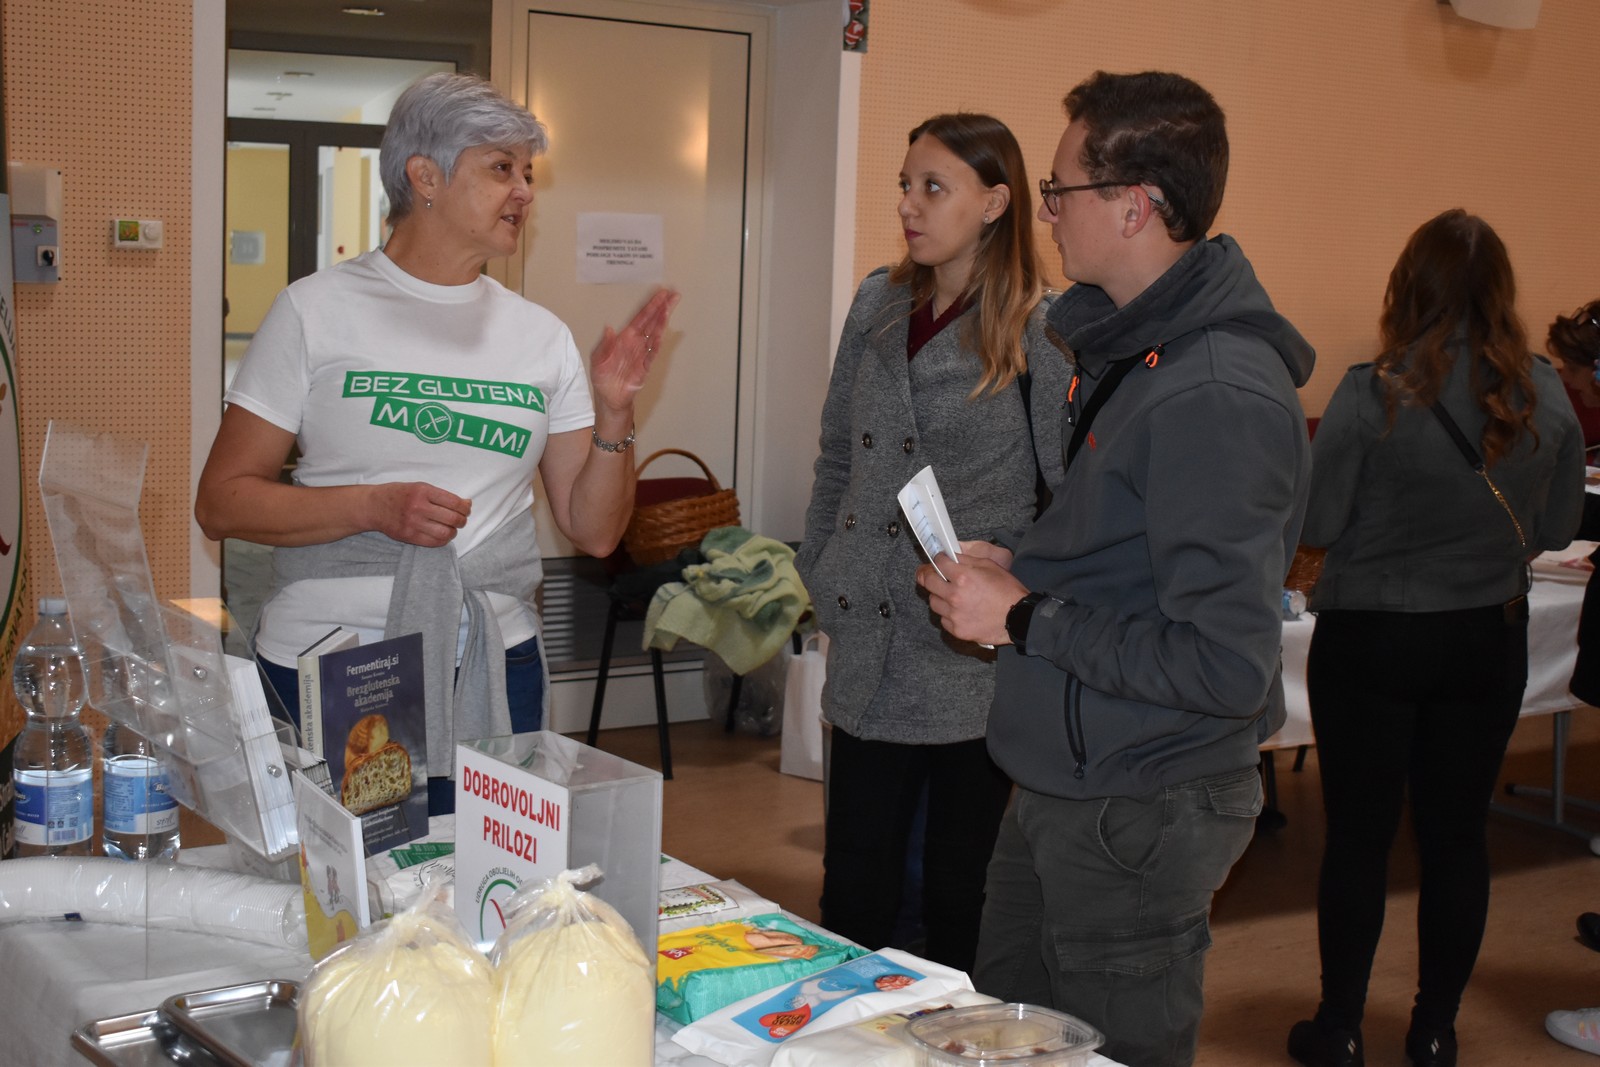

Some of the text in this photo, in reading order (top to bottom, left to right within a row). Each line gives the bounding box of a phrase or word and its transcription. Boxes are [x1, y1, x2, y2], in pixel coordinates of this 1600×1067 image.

[350, 376, 410, 394] BEZ
[346, 653, 399, 677] Fermentiraj.si
[303, 674, 314, 720] akademija
[346, 674, 401, 697] Brezglutenska
[354, 688, 394, 708] akademija
[463, 765, 560, 831] DOBROVOLJNI
[483, 815, 537, 864] PRILOZI
[475, 874, 489, 904] UDRUGA
[488, 866, 516, 880] OBOLJELIH
